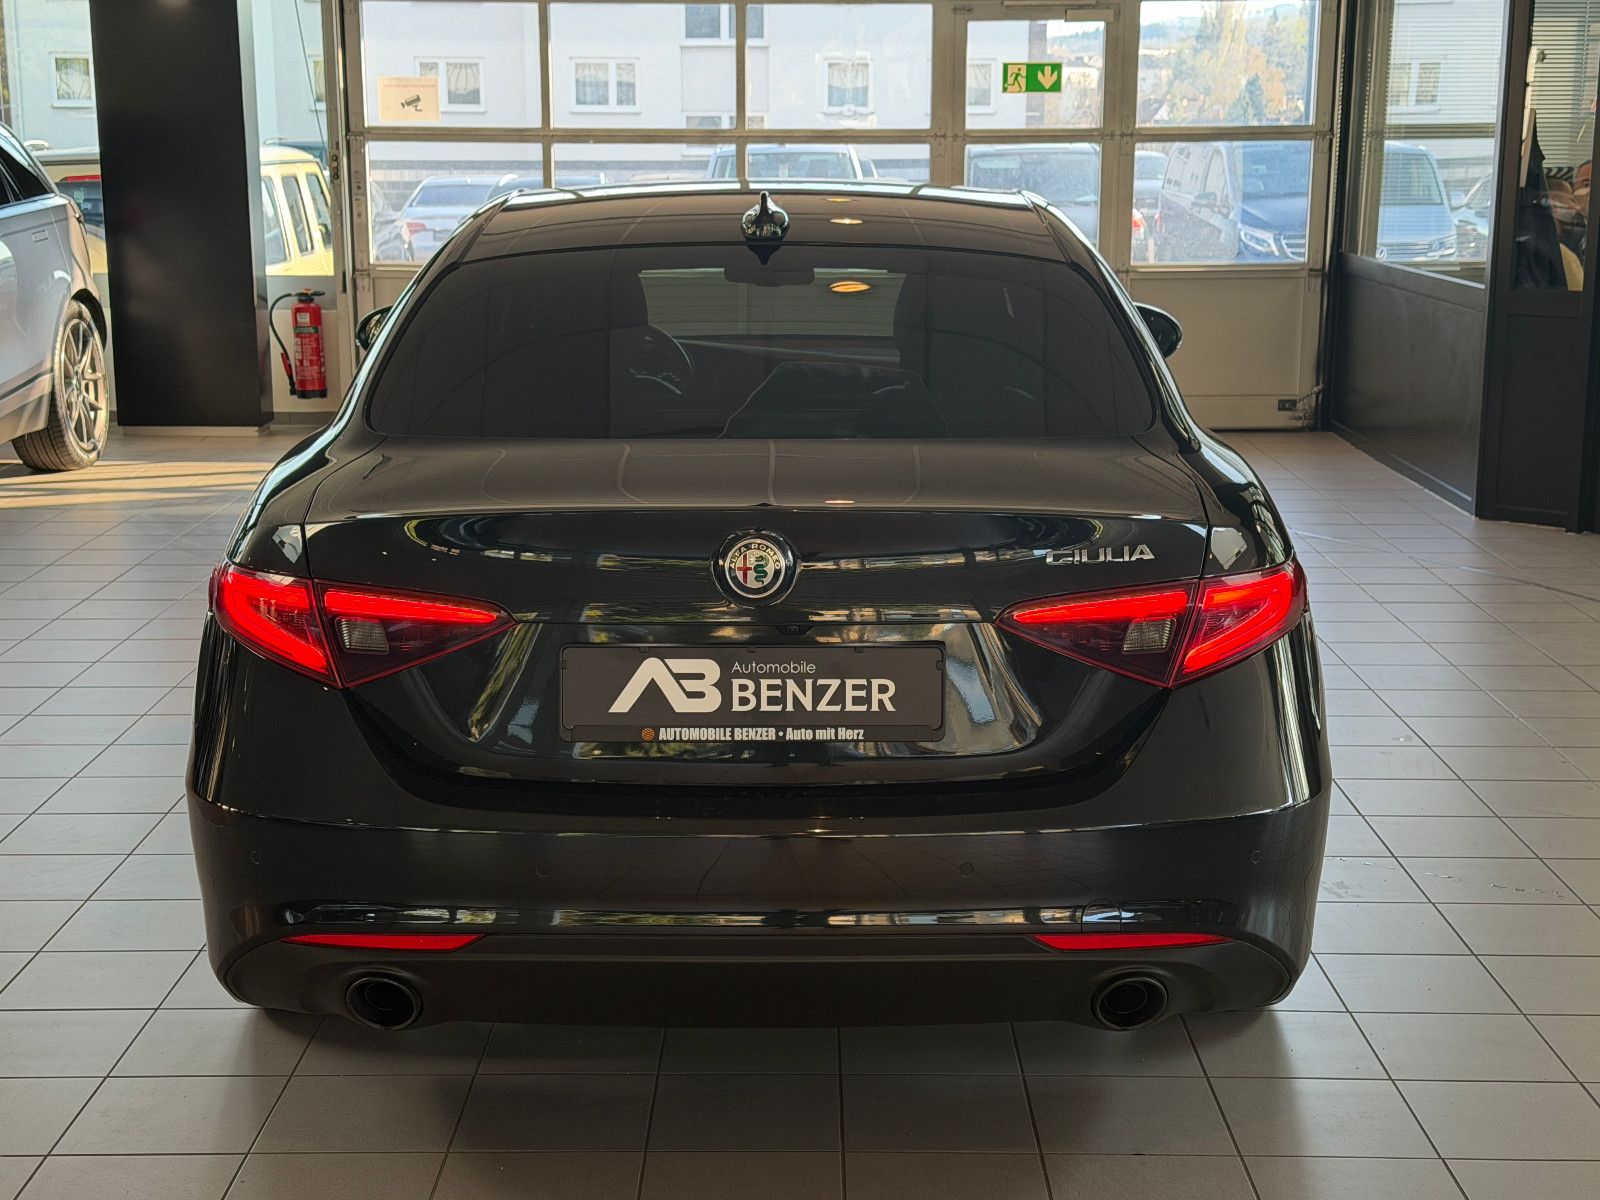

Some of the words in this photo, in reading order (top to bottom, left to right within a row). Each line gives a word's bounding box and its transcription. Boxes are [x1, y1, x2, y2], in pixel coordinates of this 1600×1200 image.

[729, 546, 748, 570] ALFA
[751, 543, 781, 570] ROMEO
[1045, 543, 1155, 565] GIULIA
[731, 661, 816, 674] Automobile
[731, 678, 896, 712] BENZER
[659, 727, 732, 741] AUTOMOBILE
[733, 727, 776, 741] BENZER
[785, 727, 814, 741] Auto
[815, 727, 836, 740] mit
[837, 727, 865, 740] Herz
